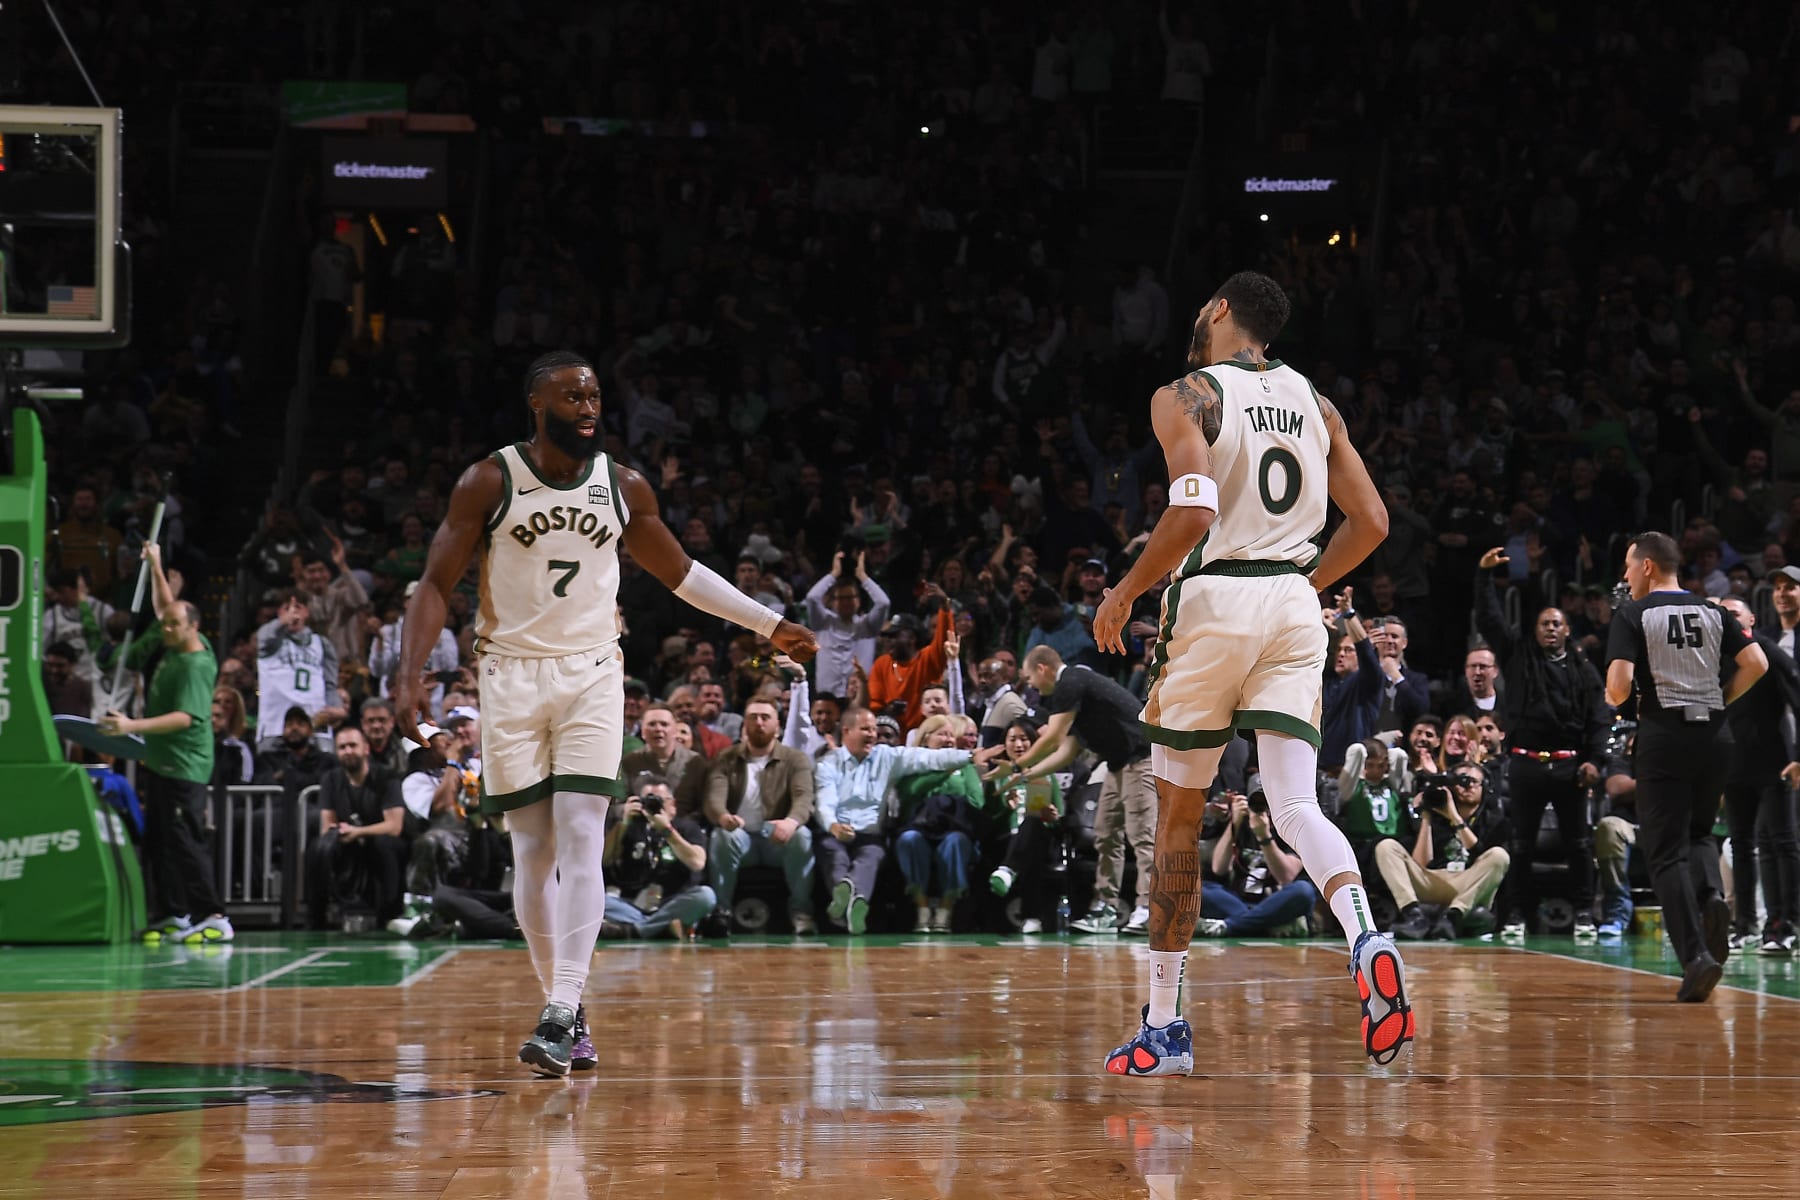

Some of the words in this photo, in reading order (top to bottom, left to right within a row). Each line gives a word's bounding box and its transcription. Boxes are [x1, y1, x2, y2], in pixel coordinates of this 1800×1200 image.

[334, 162, 428, 179] ticketmaster
[1245, 177, 1332, 192] ticketmaster
[1244, 406, 1304, 438] TATUM
[1185, 478, 1200, 498] 0
[1258, 445, 1304, 517] 0
[509, 506, 613, 549] BOSTON
[547, 559, 581, 598] 7
[1667, 613, 1703, 649] 45
[295, 668, 310, 692] 0
